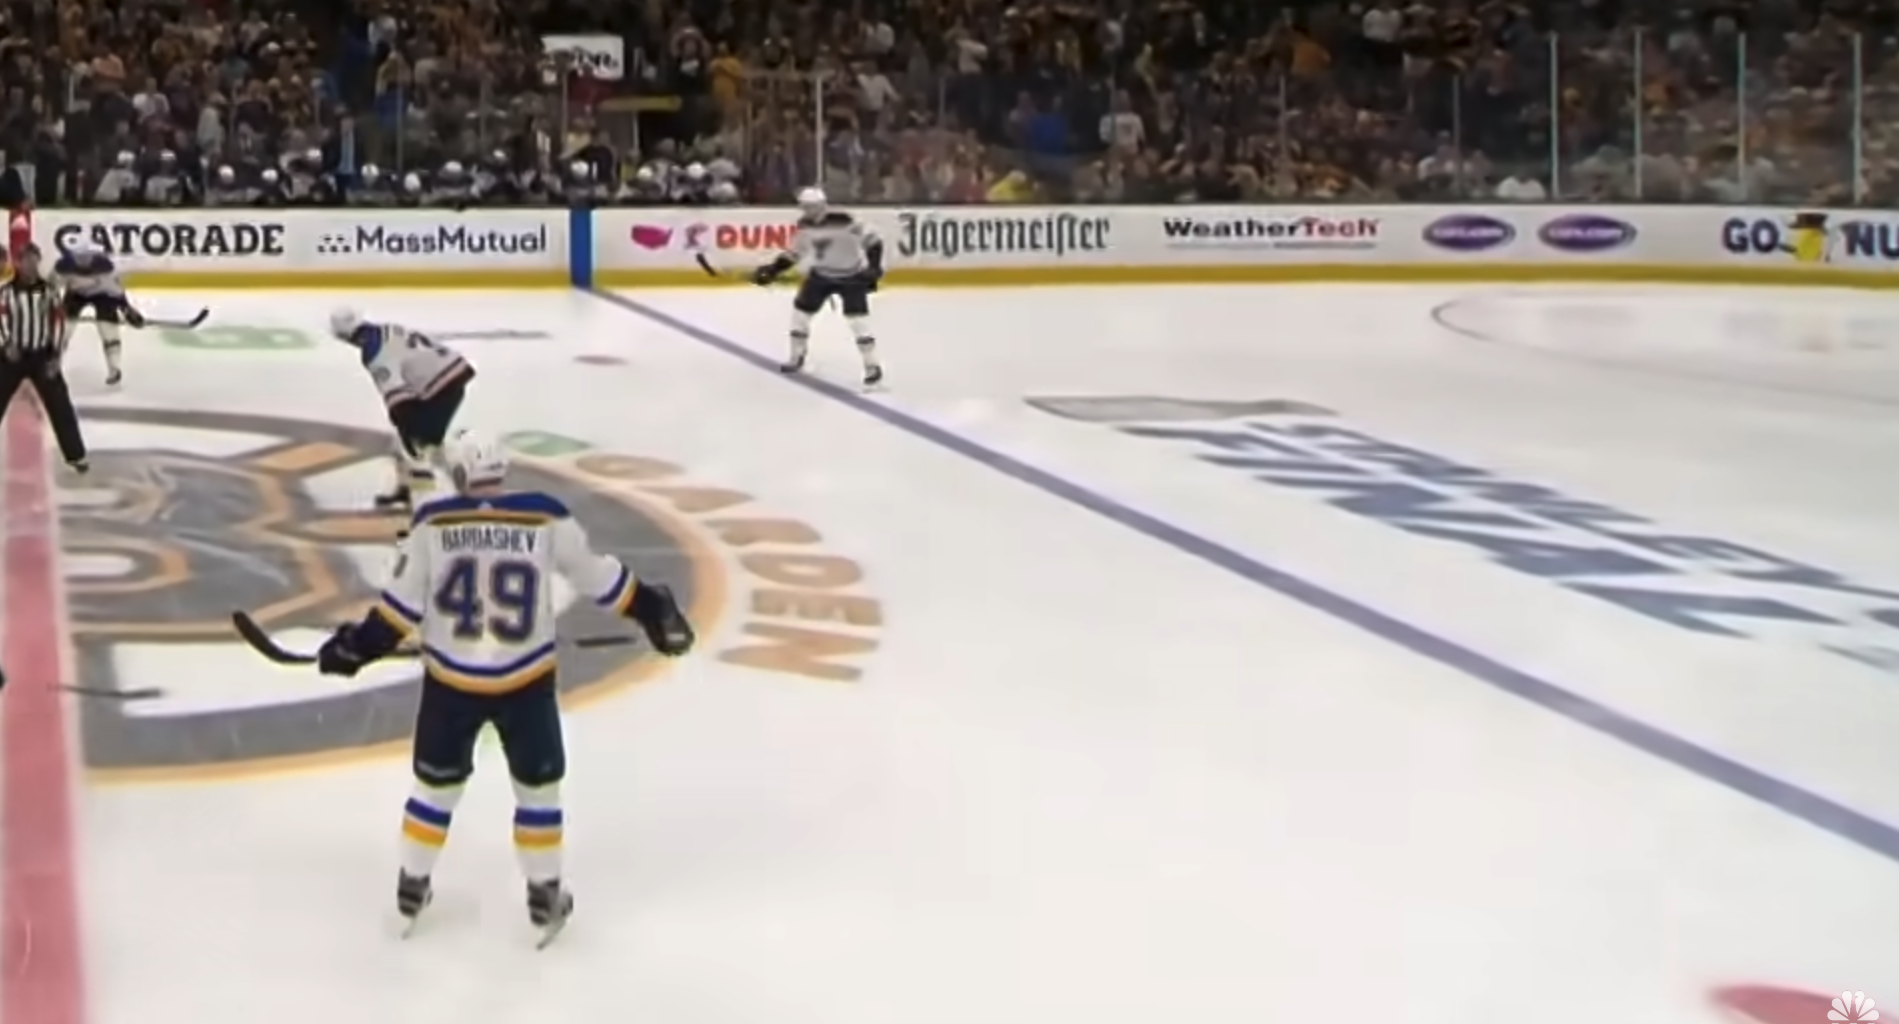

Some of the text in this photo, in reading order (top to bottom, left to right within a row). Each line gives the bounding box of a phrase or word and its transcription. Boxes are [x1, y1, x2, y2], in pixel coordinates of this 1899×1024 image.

[355, 223, 547, 254] MassMutual
[1164, 216, 1382, 237] WeatherTech
[1723, 218, 1779, 253] GO
[434, 557, 540, 643] 49
